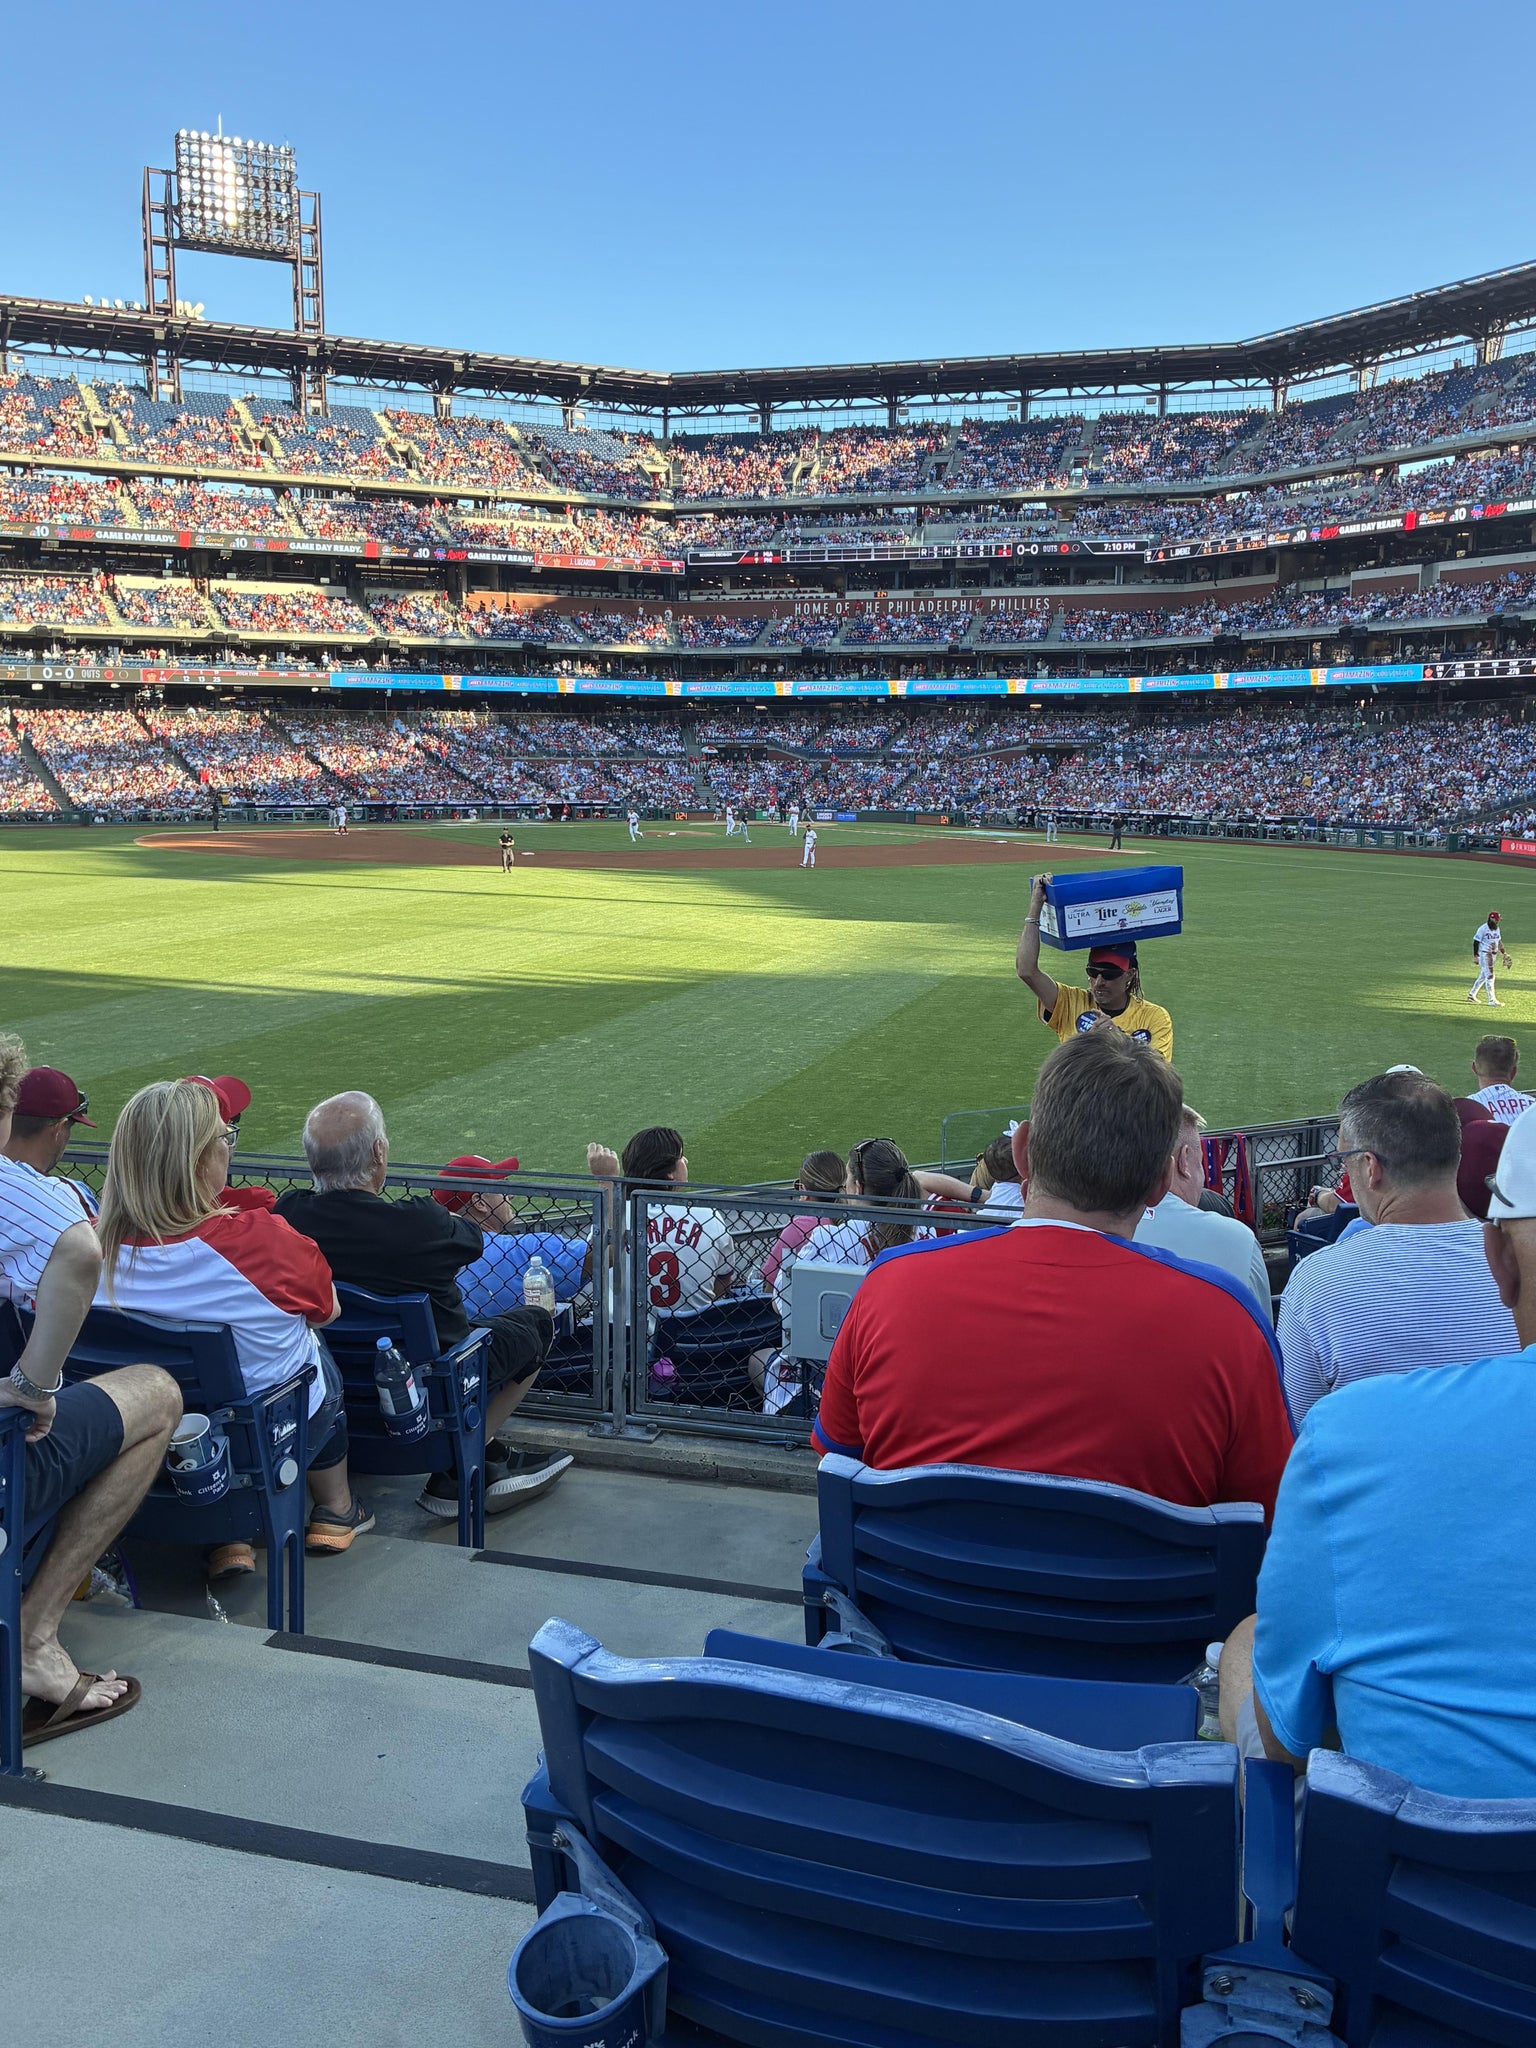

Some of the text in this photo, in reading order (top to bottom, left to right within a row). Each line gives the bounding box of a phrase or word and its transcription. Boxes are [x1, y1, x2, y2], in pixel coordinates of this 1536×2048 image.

[1506, 500, 1533, 512] GAME
[35, 525, 49, 537] 10
[1340, 523, 1360, 535] GAME
[1361, 521, 1377, 532] DAY
[1376, 518, 1403, 530] READY.
[95, 531, 124, 540] GAME
[124, 532, 143, 541] DAY
[143, 533, 177, 543] READY.
[234, 538, 248, 549] 10
[289, 542, 315, 551] GAME
[315, 543, 333, 552] DAY
[333, 544, 363, 554] READY.
[1043, 545, 1058, 553] OUTS
[1104, 543, 1136, 551] 7:10 PM
[417, 547, 430, 558] 10
[921, 548, 928, 557] R
[944, 547, 951, 556] H
[967, 547, 973, 555] E
[467, 552, 491, 561] GAME
[491, 553, 508, 562] DAY
[508, 554, 535, 563] READY.
[795, 603, 828, 616] HOME
[836, 602, 850, 614] OF
[888, 600, 976, 614] PHILADELPHI
[990, 598, 1050, 612] PHILLIES
[81, 670, 101, 678] OUTS
[1068, 911, 1091, 919] ULTRA
[1096, 906, 1118, 921] Lite
[1487, 1098, 1536, 1115] ARPE
